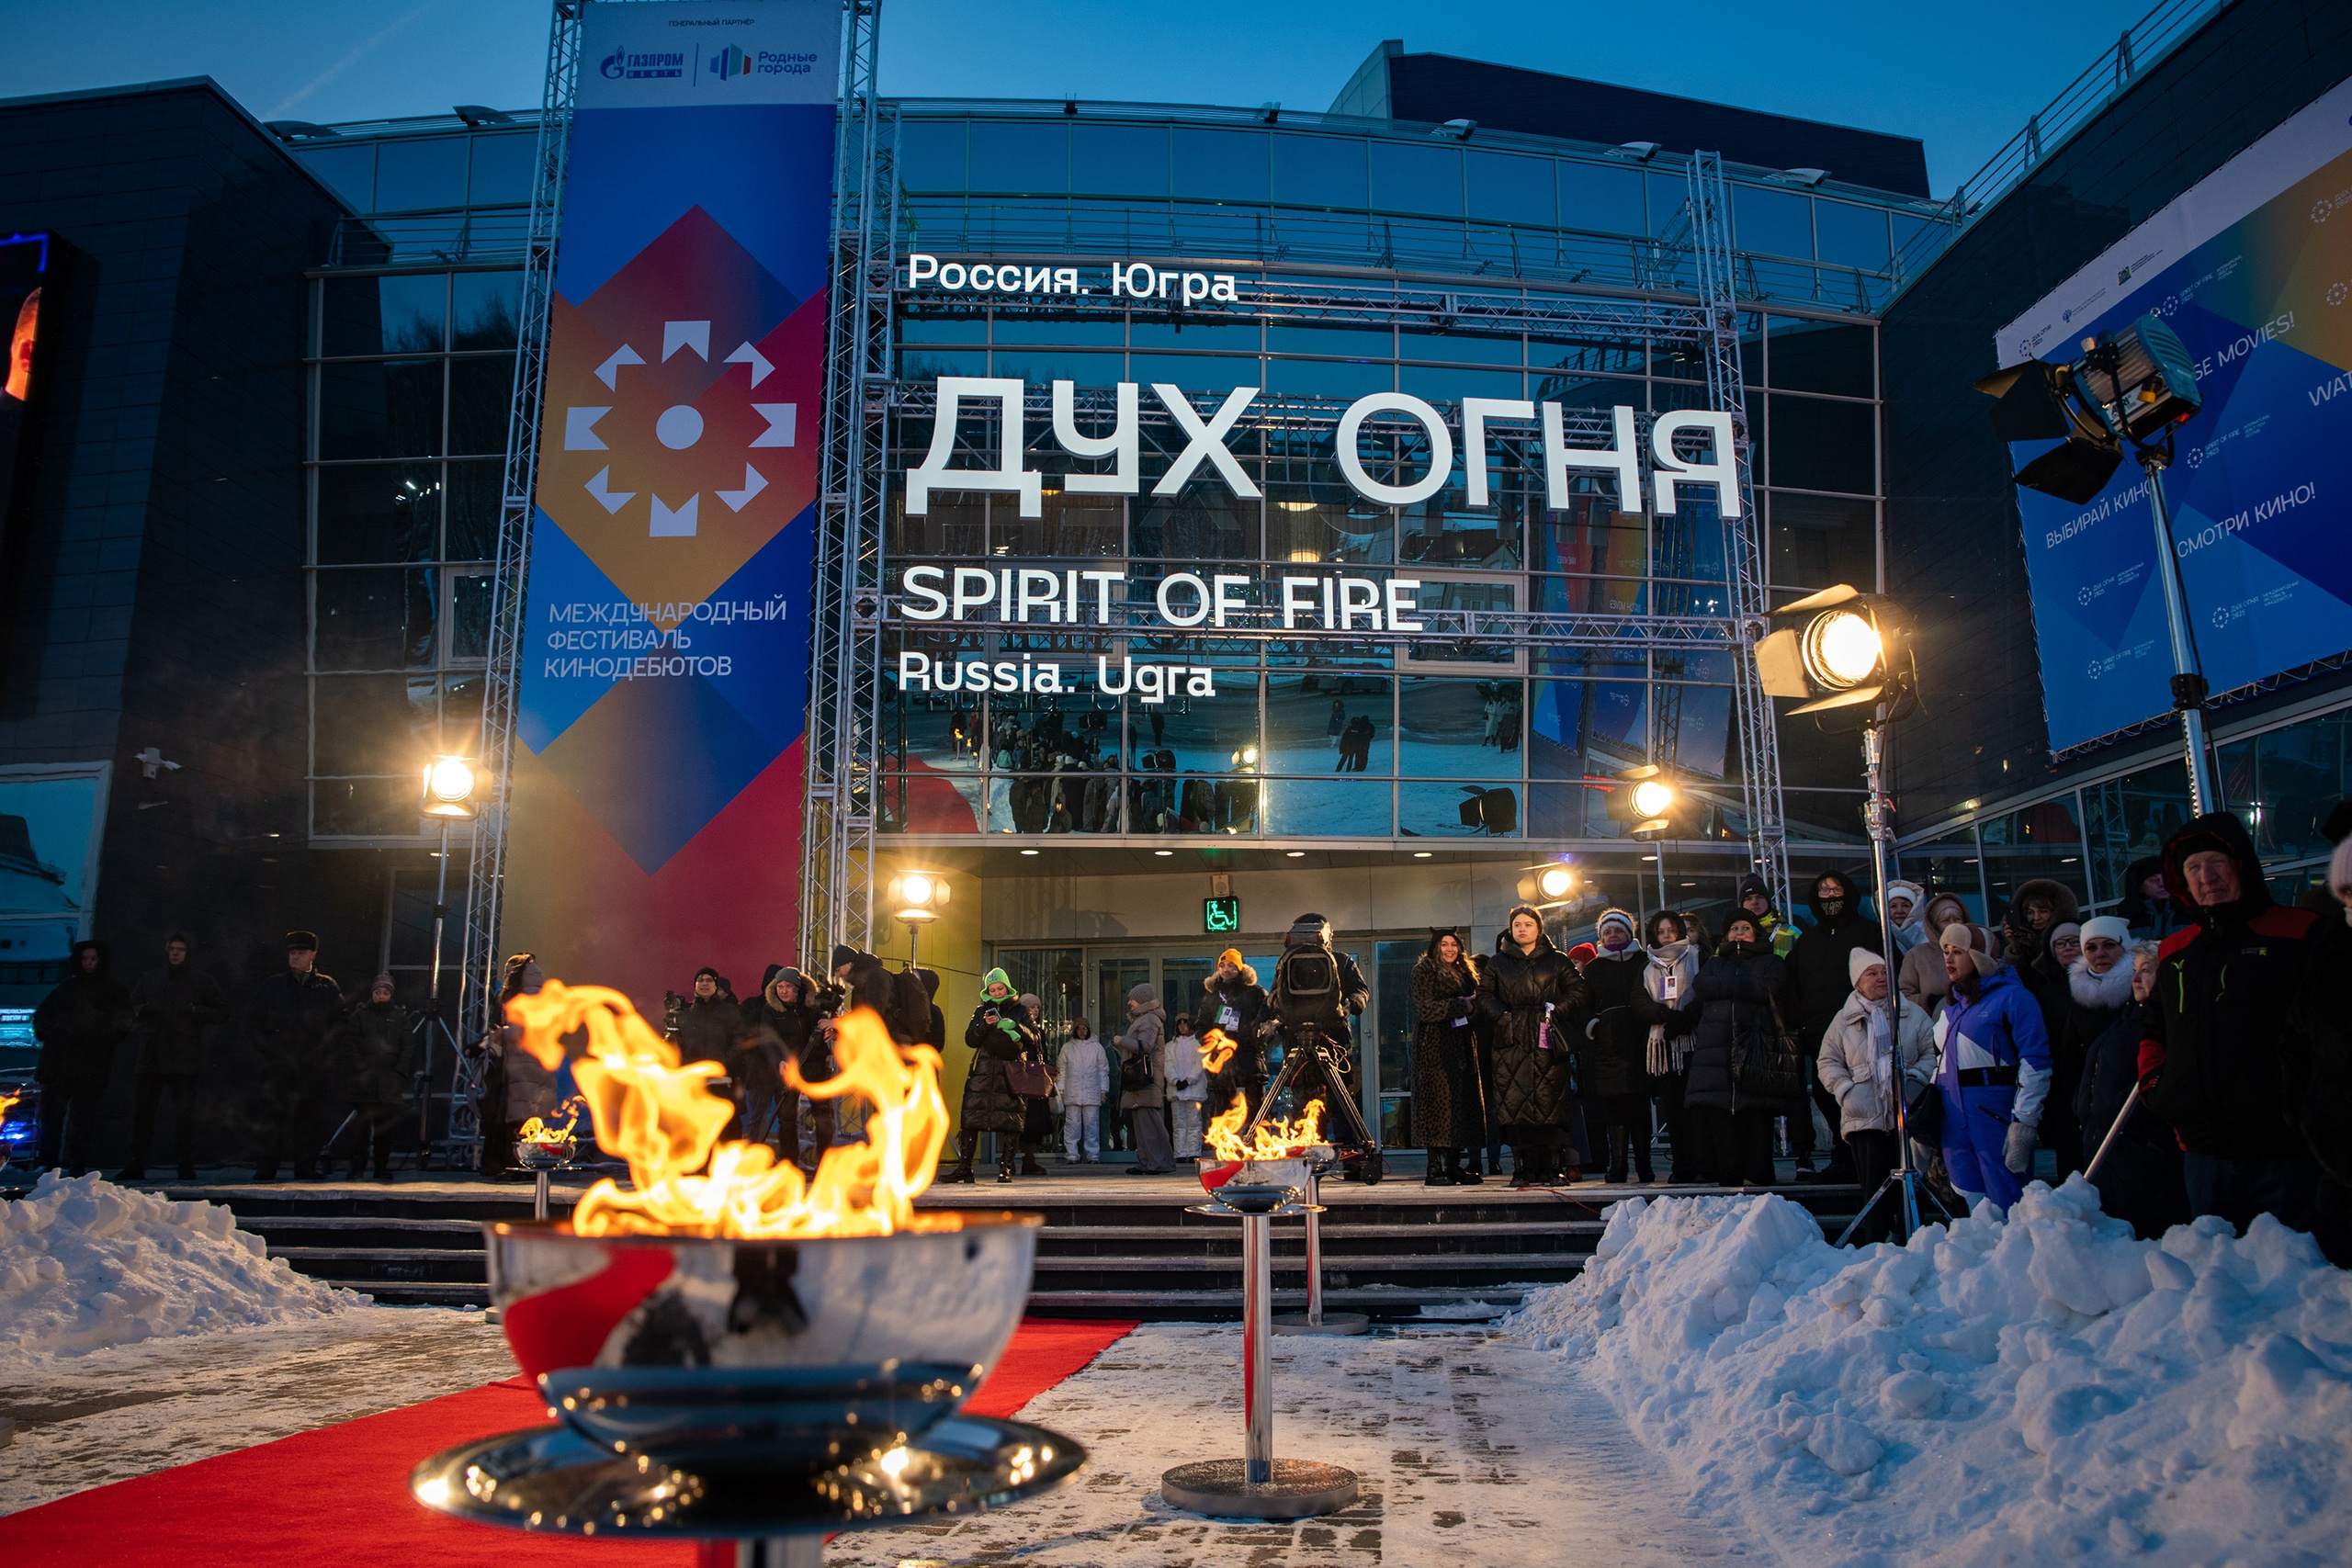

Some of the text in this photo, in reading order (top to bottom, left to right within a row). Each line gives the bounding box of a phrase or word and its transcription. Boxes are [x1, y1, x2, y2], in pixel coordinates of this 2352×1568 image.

[669, 18, 720, 27] ГЕНЕРАЛЬНЫЙ
[628, 53, 684, 67] ГАЗПРОМ
[629, 70, 683, 79] НЕФТЬ
[758, 63, 811, 75] города
[759, 51, 818, 65] Родные
[909, 254, 1238, 307] Россия. Югра
[2217, 310, 2295, 367] MOVIES!
[906, 377, 1740, 520] ДУХ ОГНЯ
[2046, 499, 2111, 550] ВЫБИРАЙ
[2177, 481, 2316, 558] СМОТРИ КИНО!
[548, 593, 786, 626] МЕЖДУНАРОДНЫЙ
[900, 565, 1424, 632] SPIRIT OF FIRE
[547, 628, 691, 650] ФЕСТИВАЛЬ
[544, 656, 732, 682] КИНОДЕБЮТОВ
[899, 651, 1077, 696] Russia.
[1099, 656, 1216, 705] Ugra
